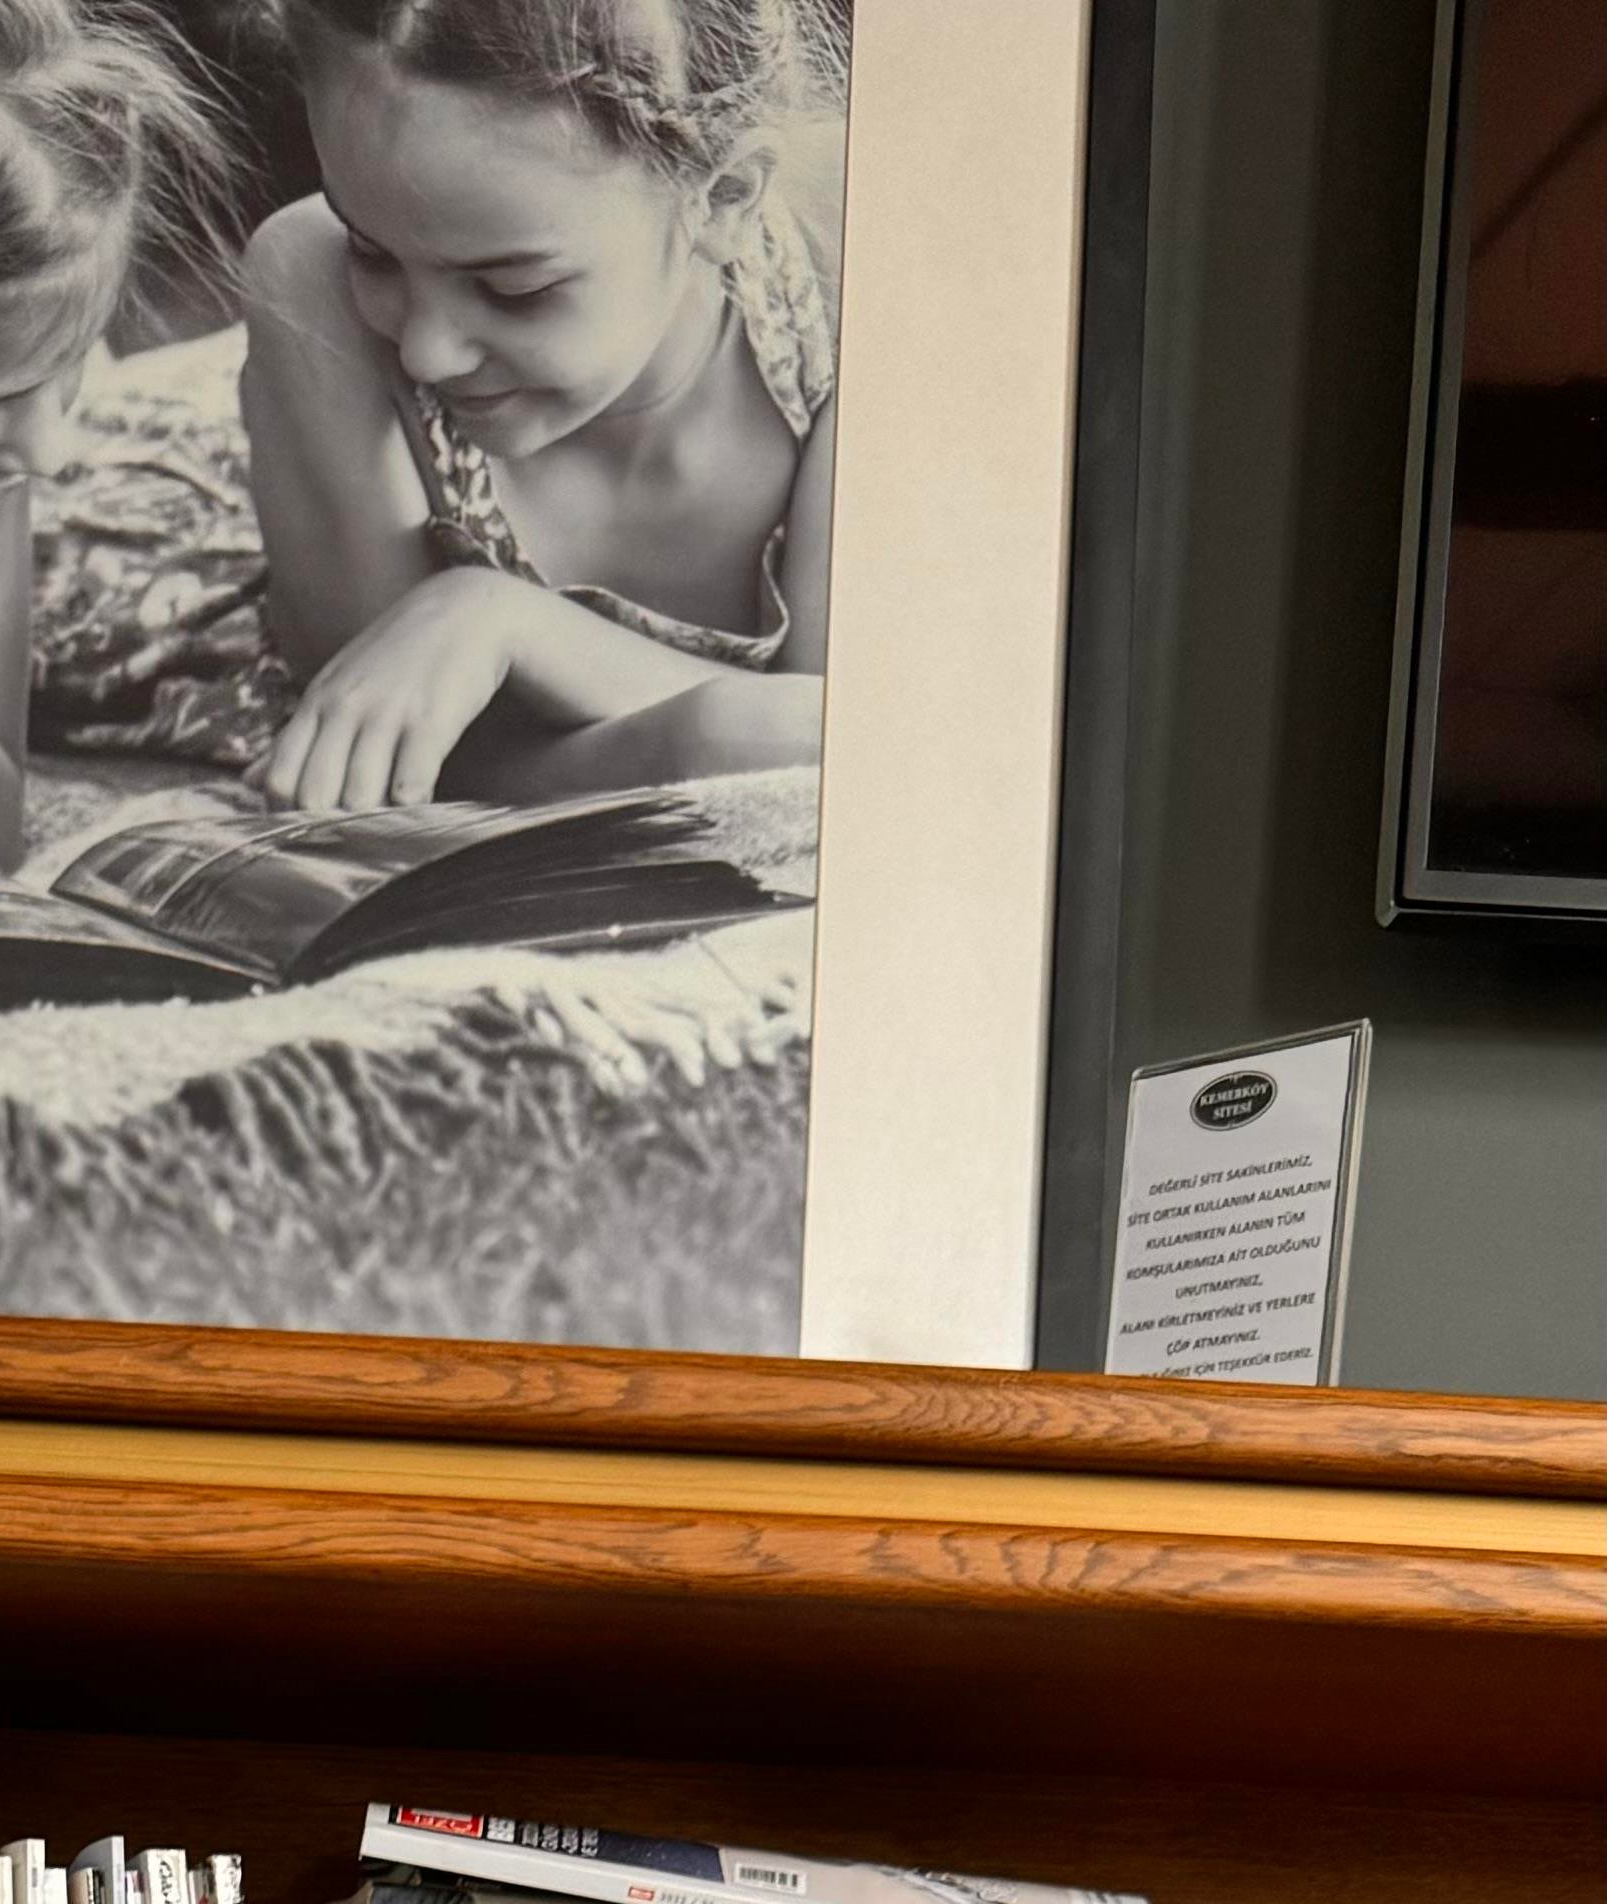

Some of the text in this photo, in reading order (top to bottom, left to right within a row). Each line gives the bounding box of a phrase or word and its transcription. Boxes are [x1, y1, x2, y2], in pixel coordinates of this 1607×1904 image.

[1199, 1083, 1270, 1106] KEMERKÖY
[1212, 1100, 1253, 1120] SİTESİ
[1149, 1174, 1197, 1196] DEĞERLİ
[1200, 1168, 1224, 1188] SİTE
[1127, 1179, 1332, 1228] SİTE ORTAK KULLANIM ALANLARINI
[1146, 1210, 1307, 1250] KULLANIRKEN ALANIN TÜM
[1125, 1235, 1322, 1282] KOMŞULARIMIZA AİT OLDUĞUNU
[1120, 1292, 1316, 1335] ALANI KİRLETMEYİNİZ VE YERLERE
[1166, 1339, 1190, 1357] ÇÖP
[1218, 1352, 1271, 1373] TEŞEKKÜR
